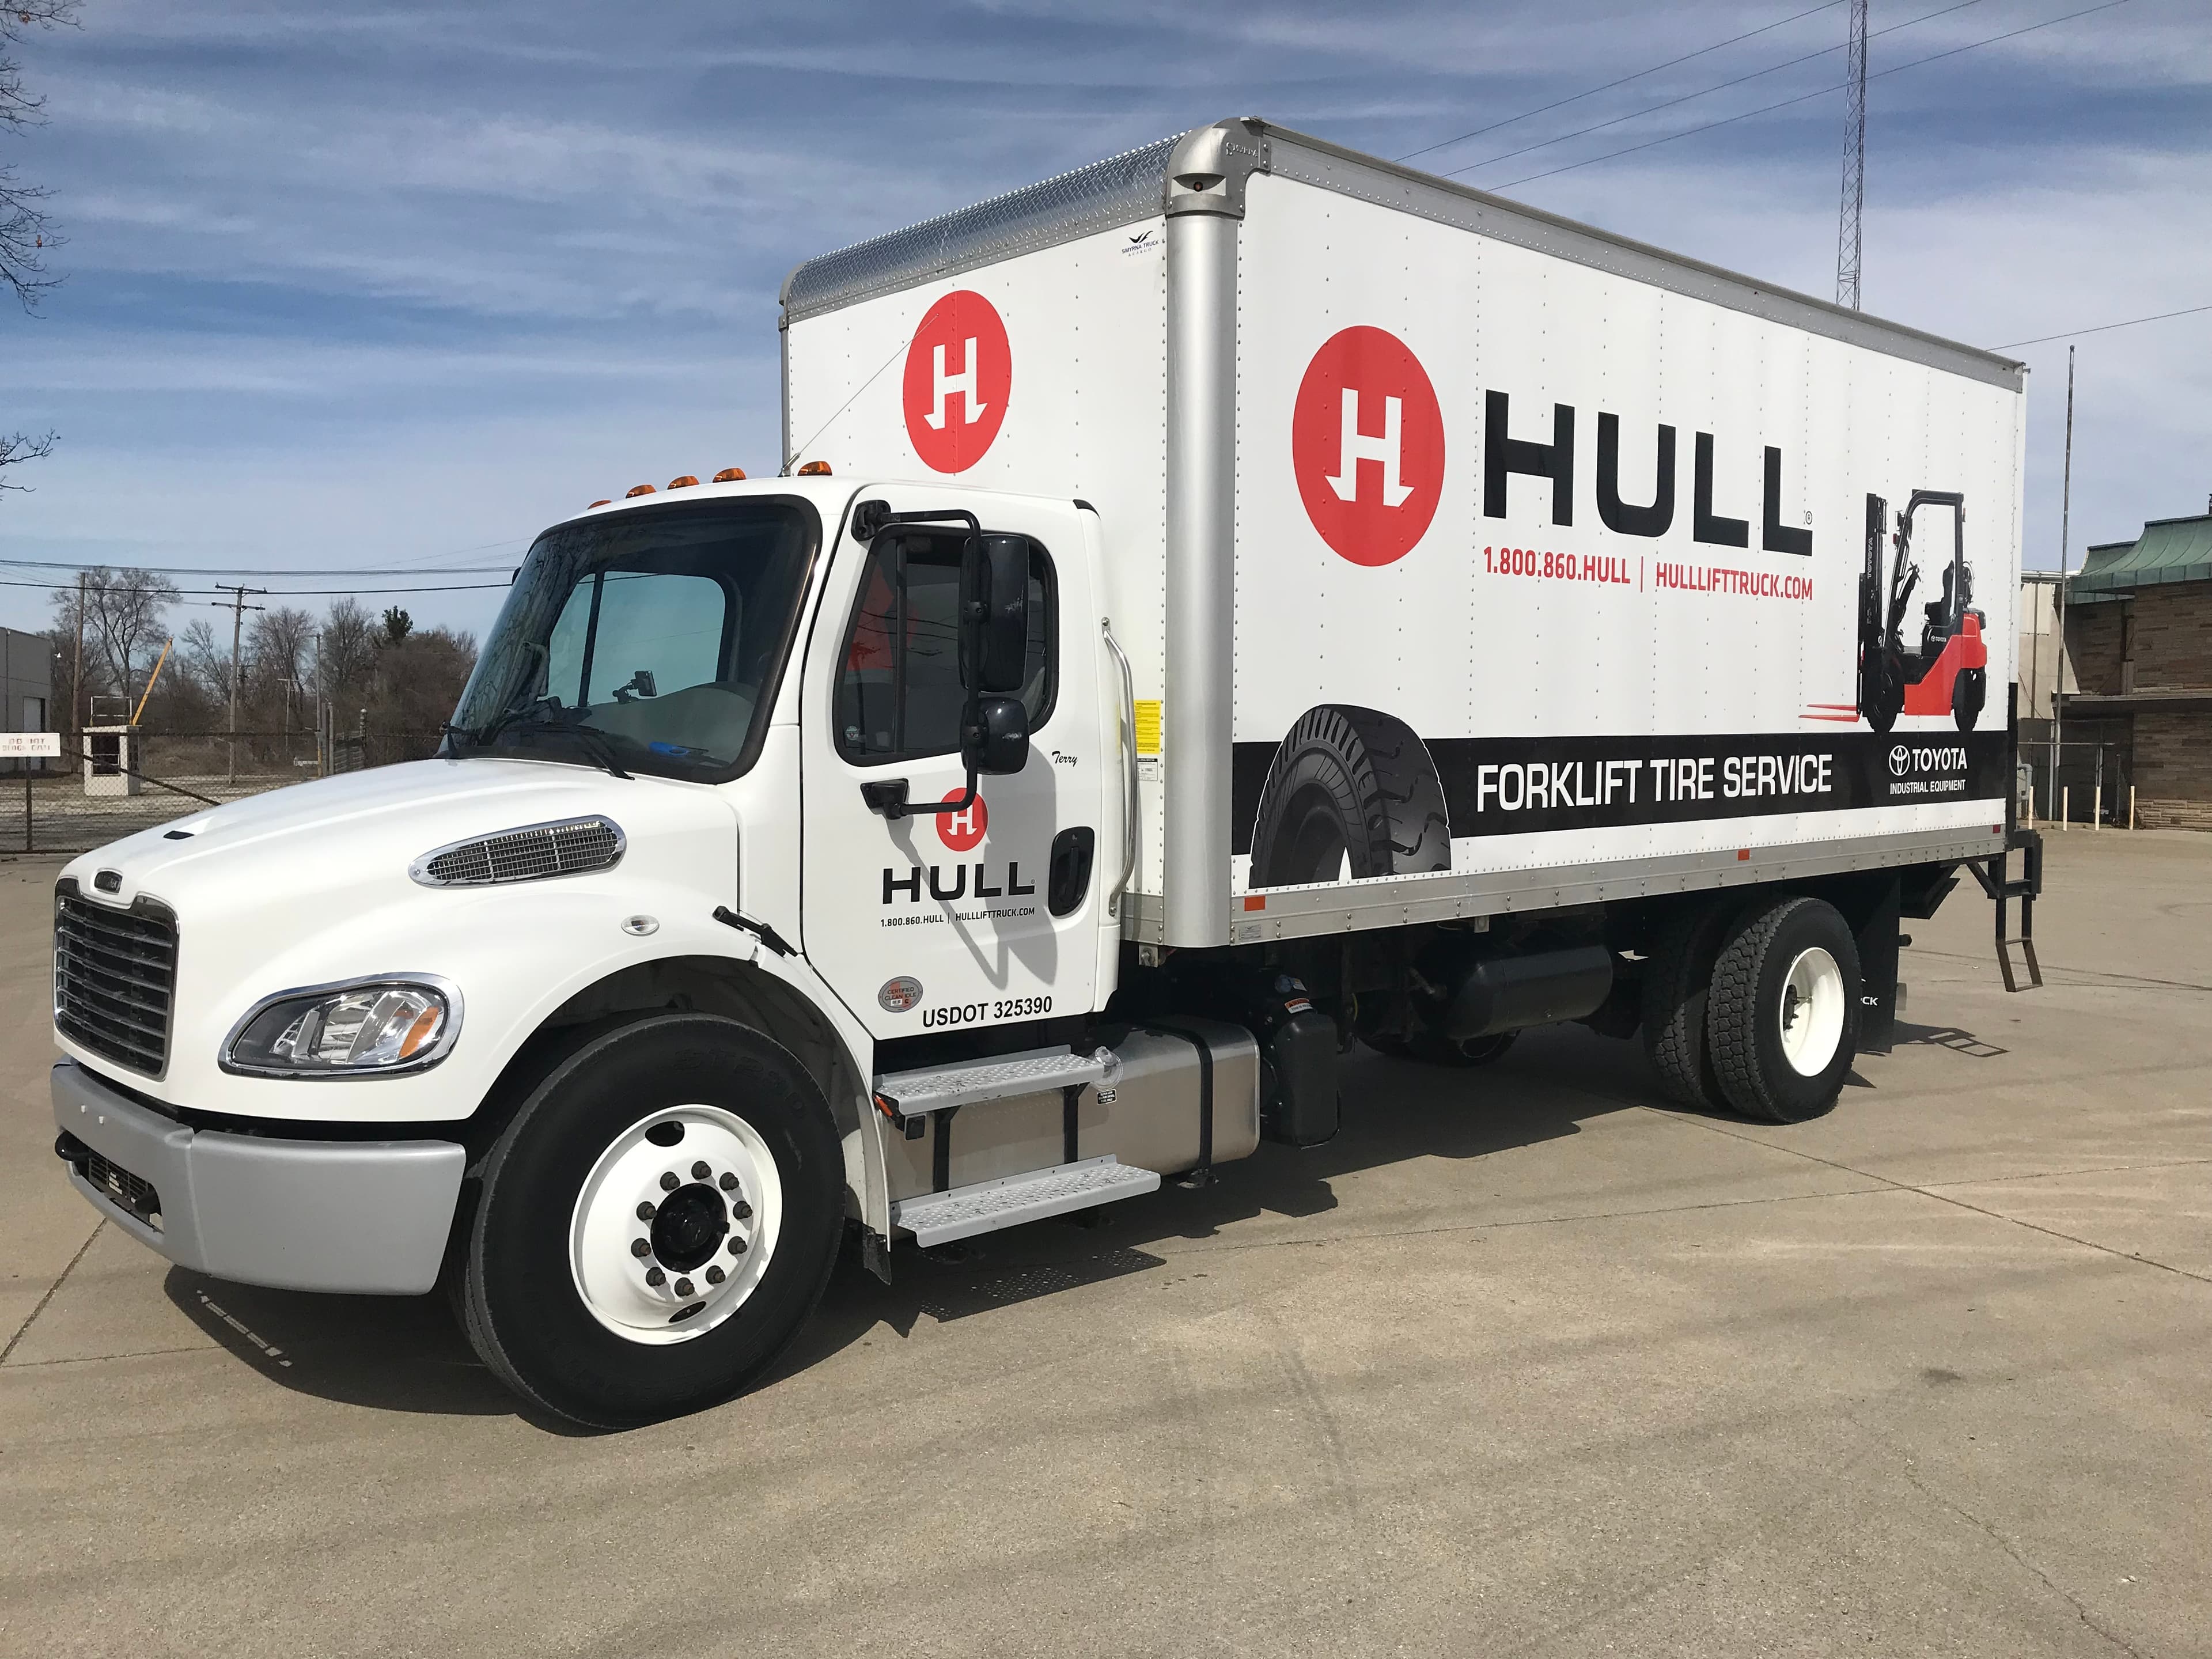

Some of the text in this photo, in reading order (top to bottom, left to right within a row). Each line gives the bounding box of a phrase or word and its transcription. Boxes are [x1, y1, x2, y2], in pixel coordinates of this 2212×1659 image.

[1122, 240, 1159, 254] SMYRNA TRUCK
[1483, 546, 1813, 600] 1.800.860.HULL HULLLIFTTRUCK.COM
[1052, 751, 1078, 767] Terry
[1912, 747, 1968, 771] TOYOTA
[1477, 754, 1833, 812] FORKLIFT TIRE SERVICE
[1890, 779, 1966, 795] INDUSTRIAL EQUIPMENT
[880, 907, 1035, 927] 1.800.860.HULL HULLLIFTTRUCK.COM
[887, 987, 914, 995] CERTIFIED
[1861, 997, 1878, 1006] CK
[923, 995, 1052, 1028] USDOT 325390
